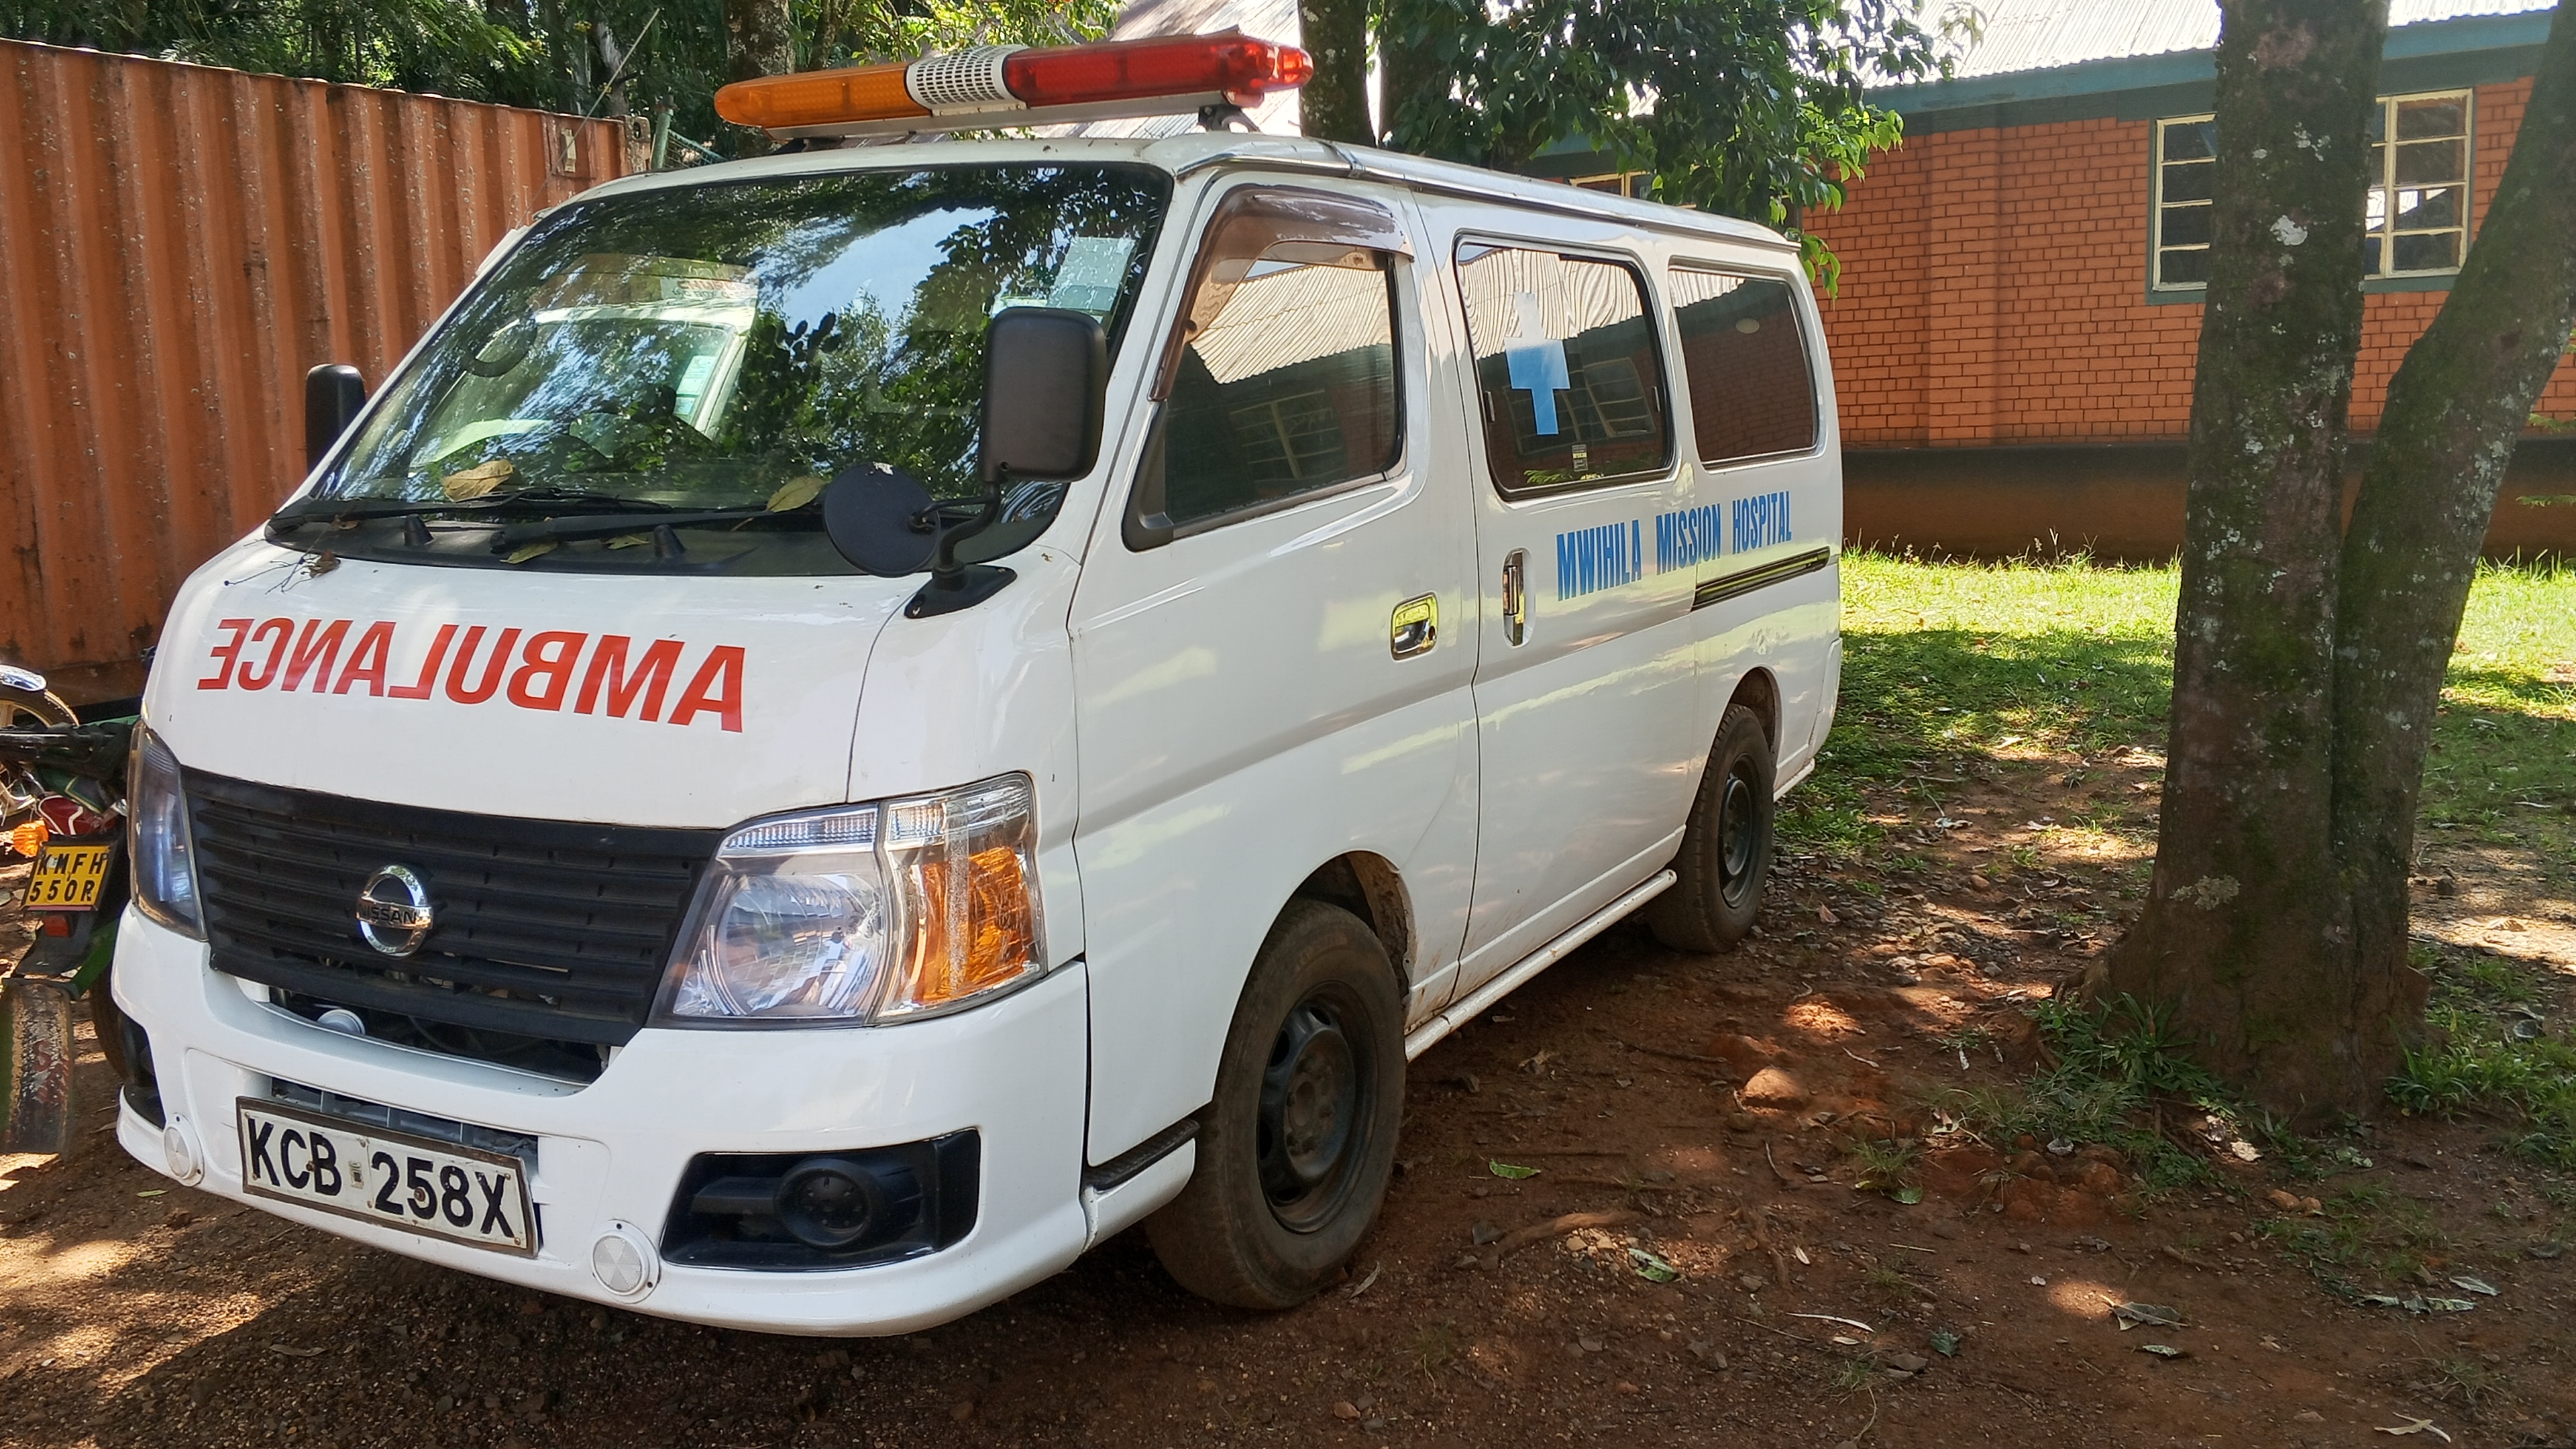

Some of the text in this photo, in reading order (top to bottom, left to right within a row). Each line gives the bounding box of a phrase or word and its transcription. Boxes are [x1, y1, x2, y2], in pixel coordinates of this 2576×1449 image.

[1556, 490, 1792, 602] MWIHILA MISSION HOSPITAL
[30, 879, 95, 902] 550R
[36, 853, 108, 875] KMFH
[248, 1117, 515, 1238] KCB 258X
